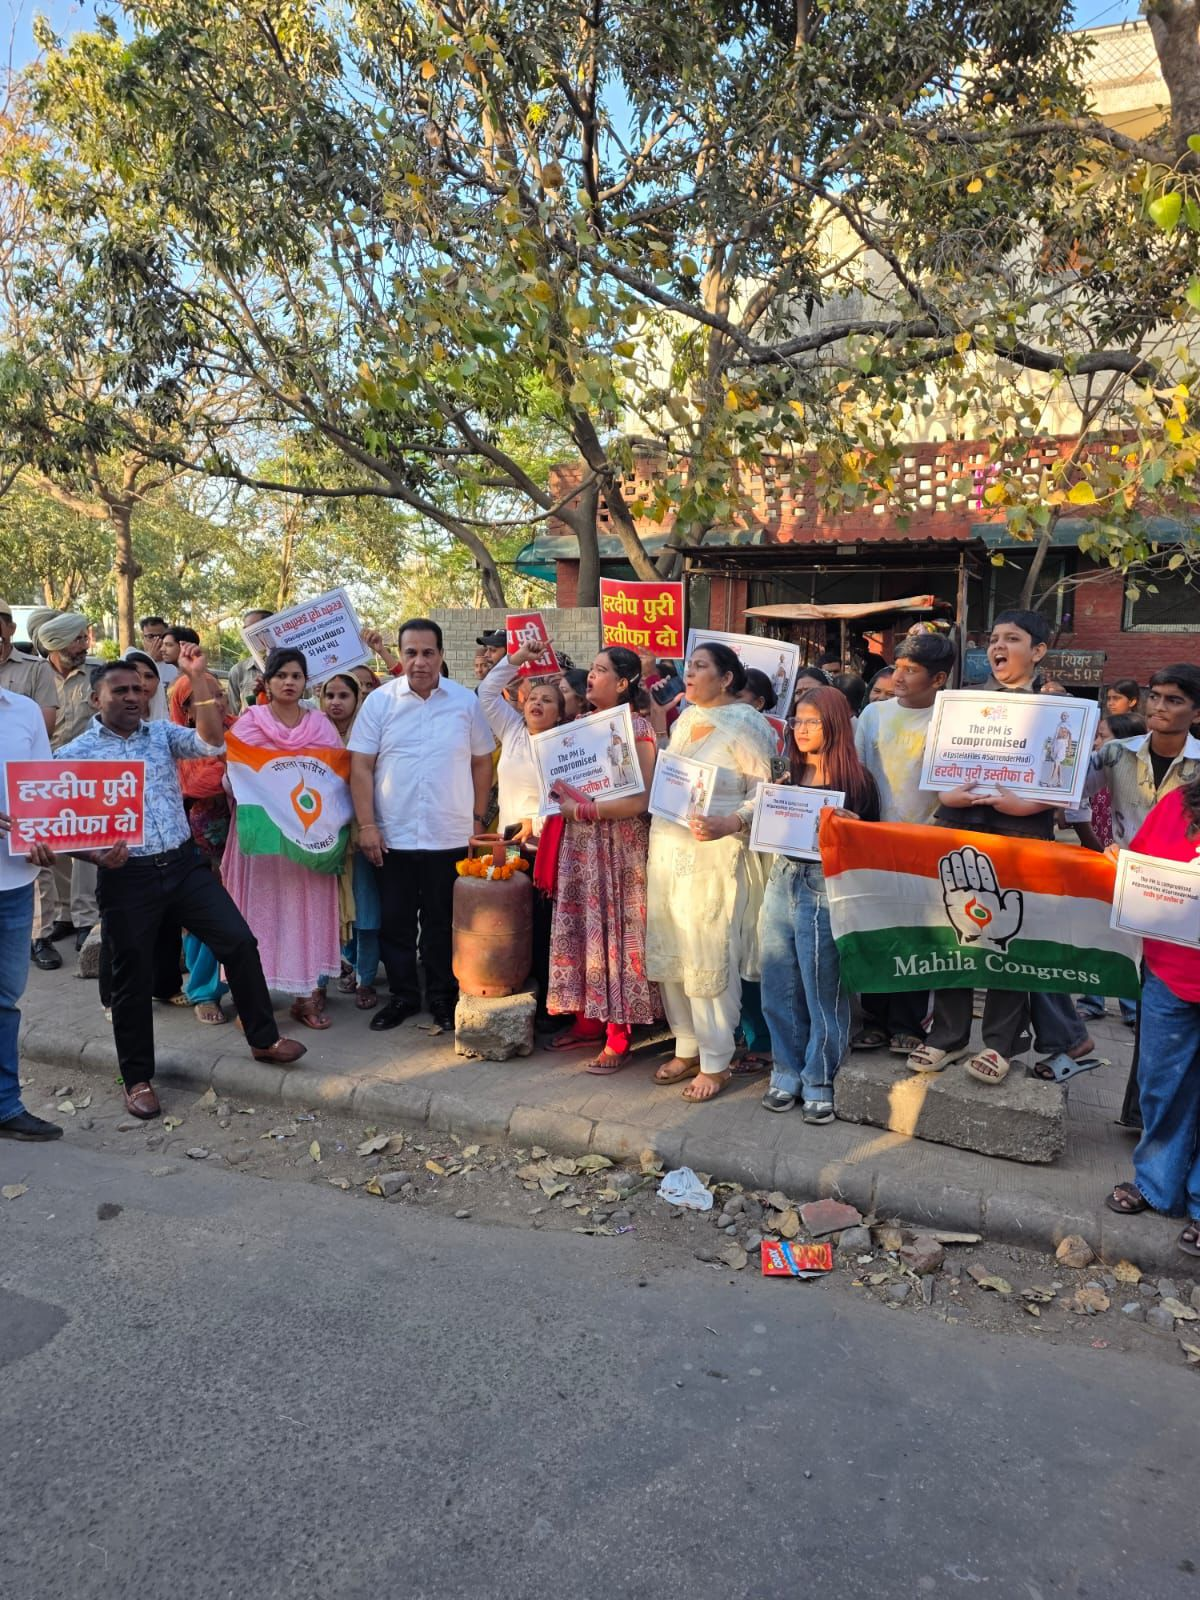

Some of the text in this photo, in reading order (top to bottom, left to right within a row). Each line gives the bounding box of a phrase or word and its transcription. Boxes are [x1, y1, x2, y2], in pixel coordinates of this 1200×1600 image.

[602, 590, 675, 623] हरदीप पुरी
[297, 626, 345, 651] compromise
[603, 621, 678, 647] इस्तीफा दो
[316, 644, 327, 654] PM
[969, 724, 1013, 736] The PM is
[951, 735, 1027, 750] compromised
[550, 754, 597, 776] compromised
[557, 748, 585, 763] The PM is
[934, 763, 1036, 784] हरदीप पुरी इस्तीफा दो
[17, 770, 138, 806] हरदीप पुरी
[17, 807, 139, 842] इस्तीफा दो
[893, 951, 1101, 985] Mahila Congress
